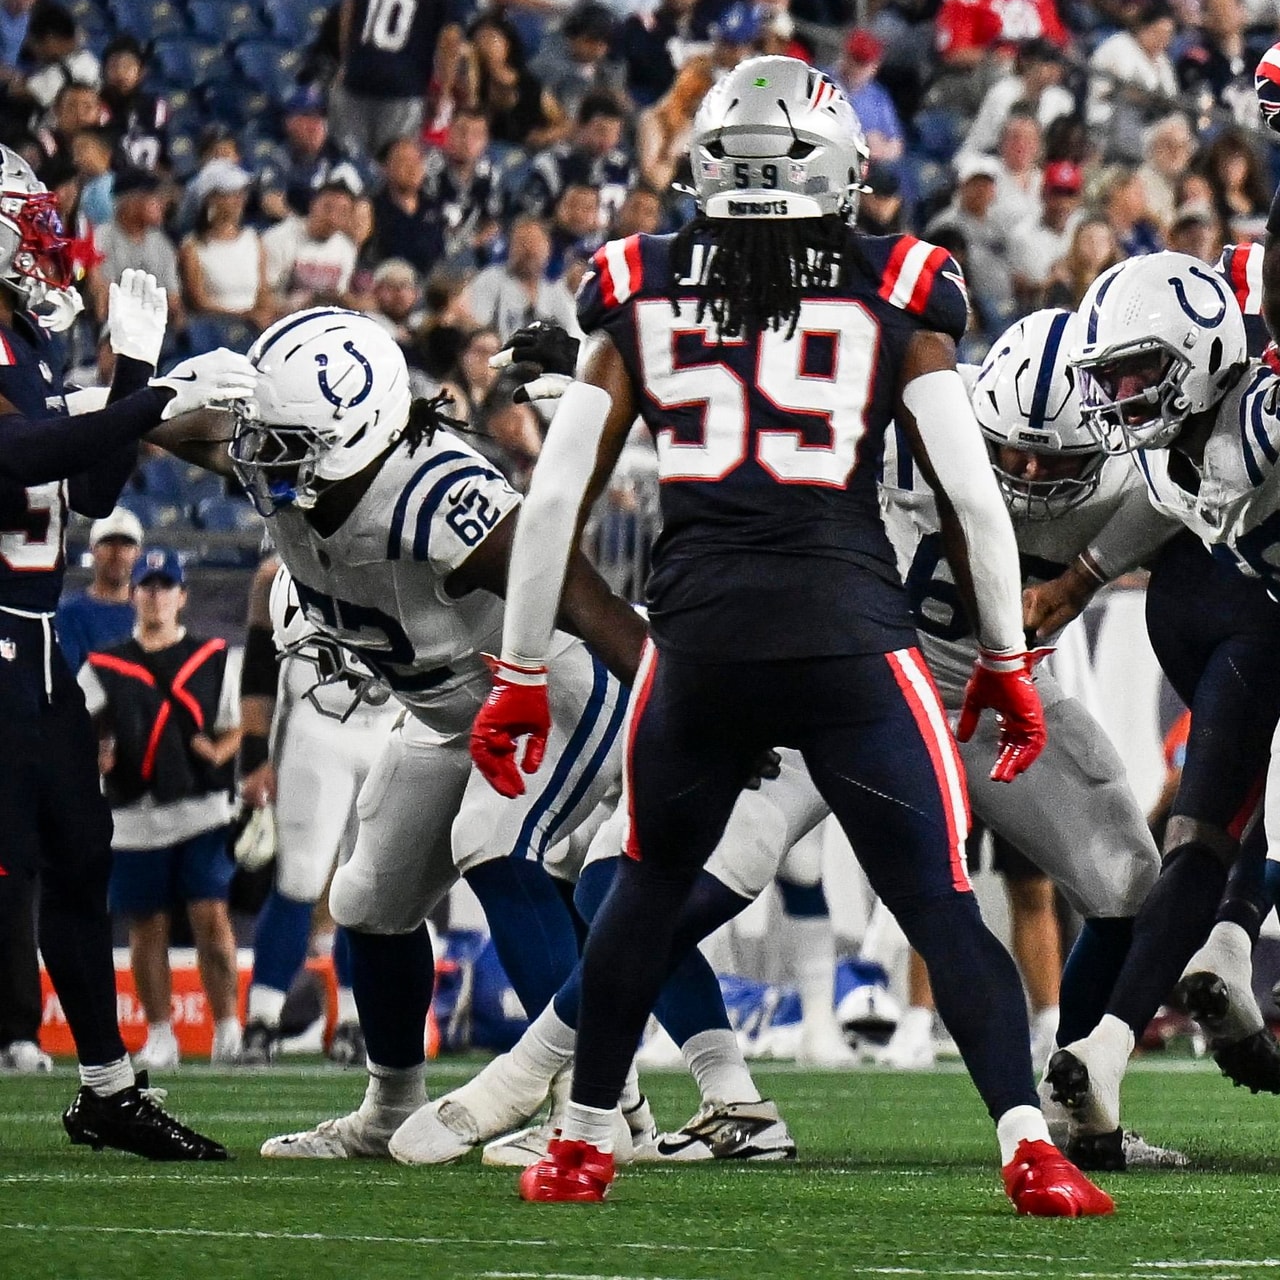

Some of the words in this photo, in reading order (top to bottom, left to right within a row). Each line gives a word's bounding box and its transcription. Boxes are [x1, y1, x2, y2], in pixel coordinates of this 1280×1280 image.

[733, 162, 778, 190] 59
[727, 199, 789, 217] PATRIOTS
[634, 296, 882, 491] 59
[446, 488, 502, 547] 62
